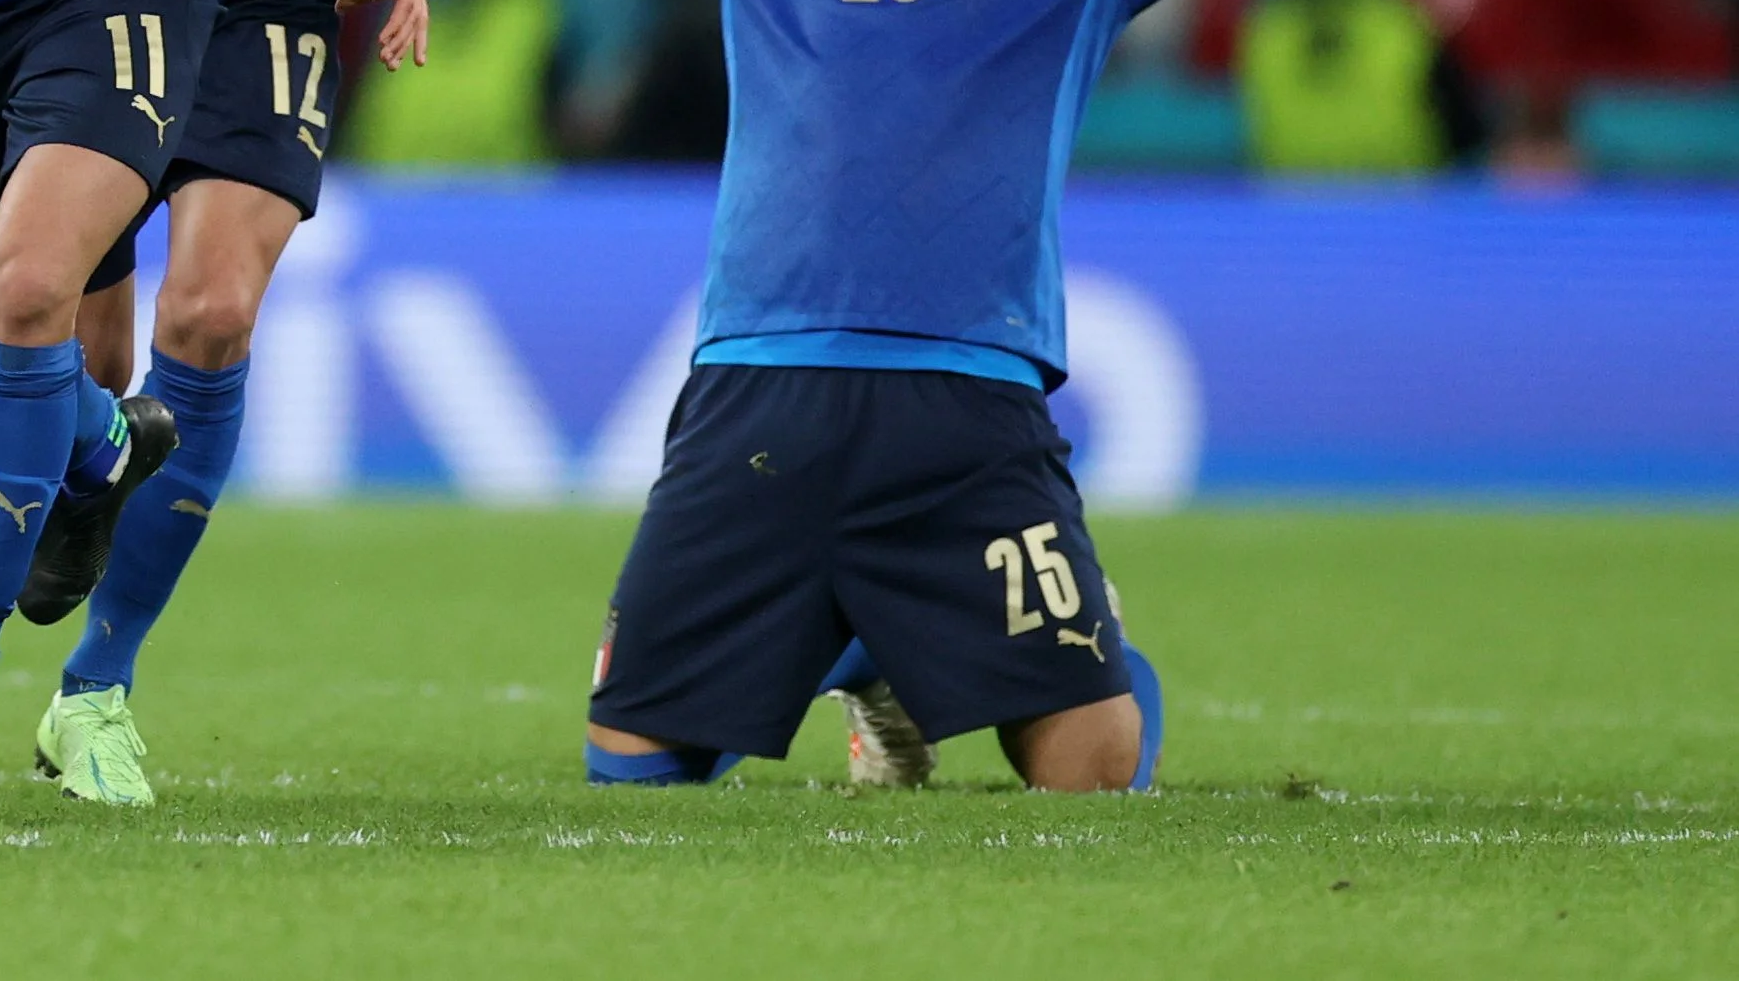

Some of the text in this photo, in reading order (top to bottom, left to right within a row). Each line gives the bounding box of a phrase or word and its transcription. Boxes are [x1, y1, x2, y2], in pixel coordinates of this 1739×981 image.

[104, 14, 166, 99] 11
[264, 23, 327, 127] 12
[984, 522, 1082, 637] 25
